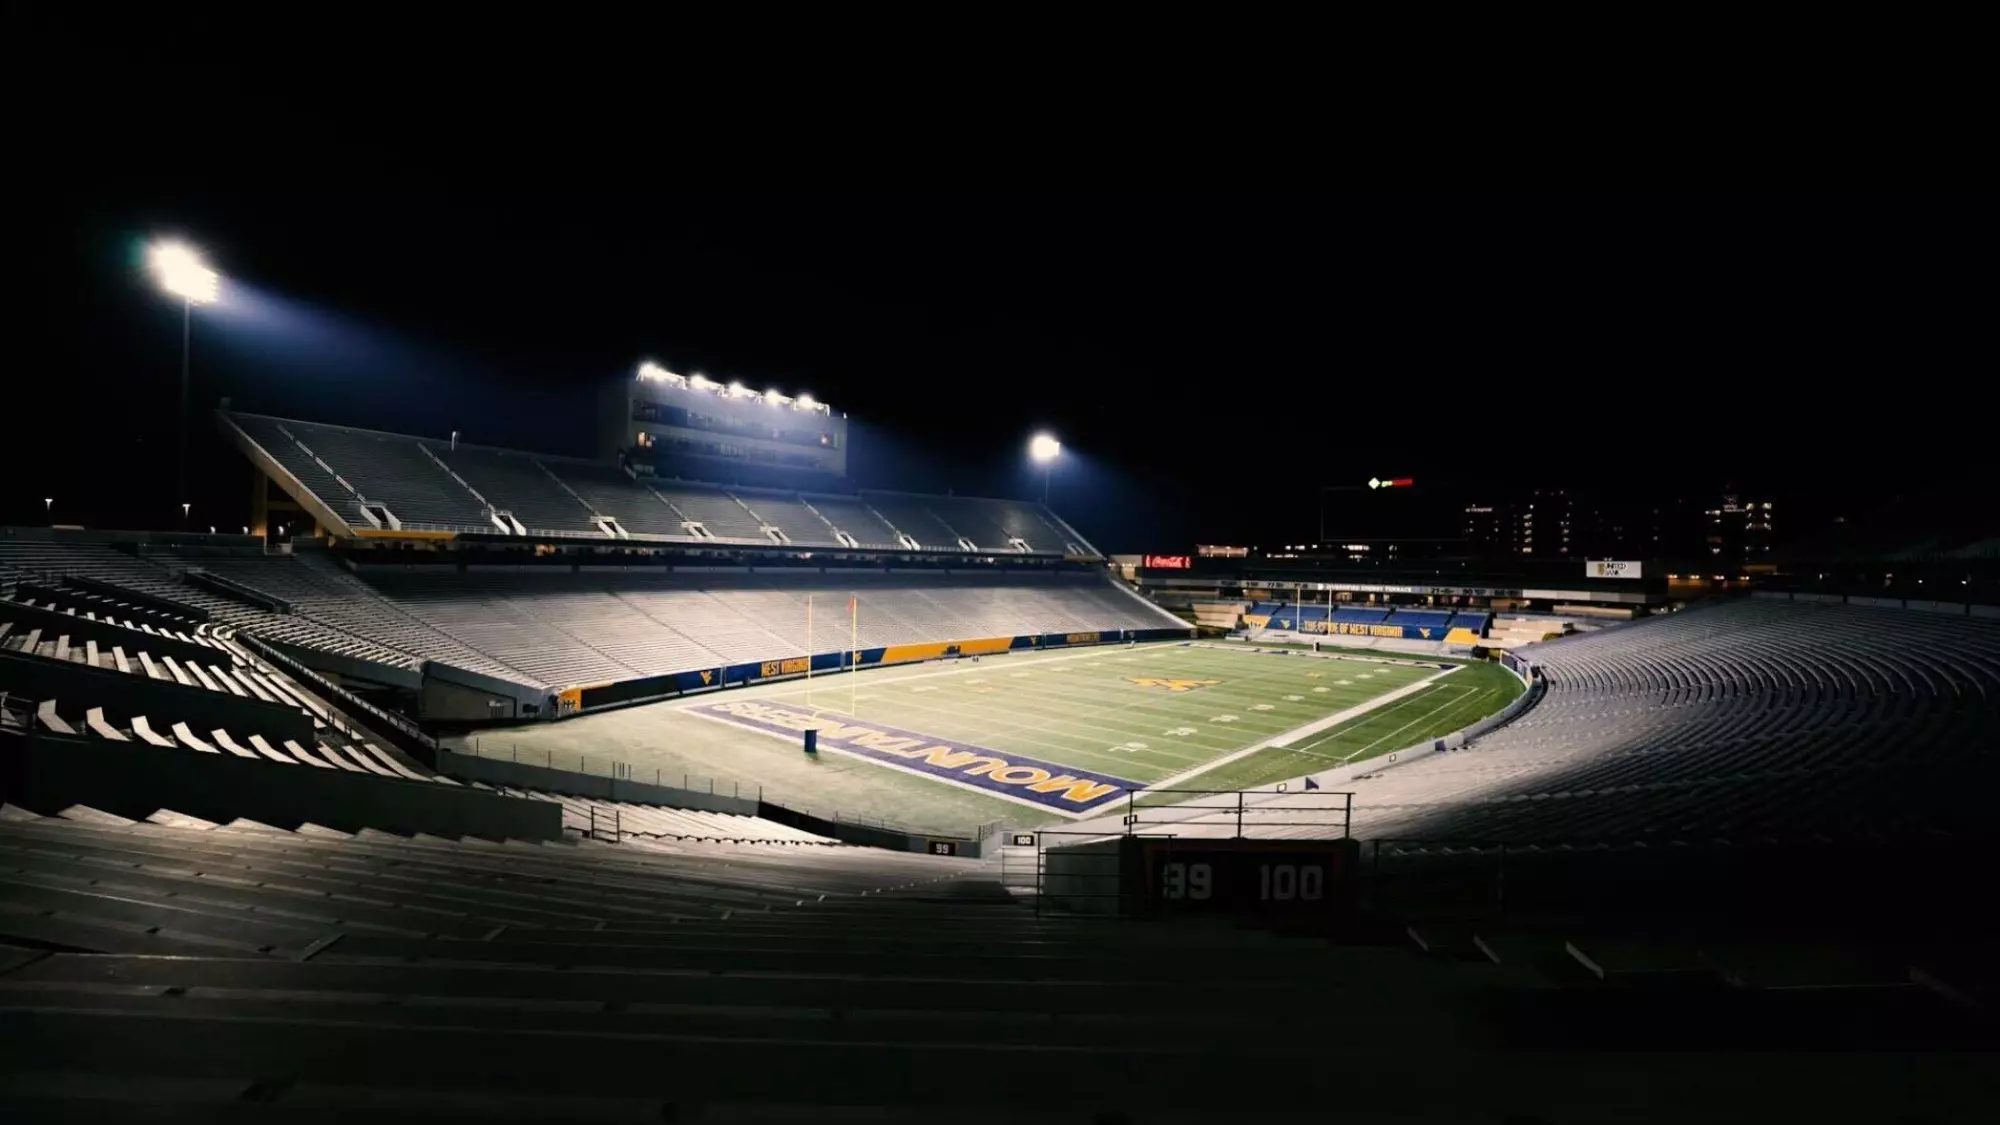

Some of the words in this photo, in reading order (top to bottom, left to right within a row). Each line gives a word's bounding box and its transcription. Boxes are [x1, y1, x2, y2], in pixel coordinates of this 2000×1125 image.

[1350, 623, 1368, 635] WEST
[761, 660, 780, 678] WEST
[935, 843, 949, 854] 99
[1259, 864, 1323, 901] 100
